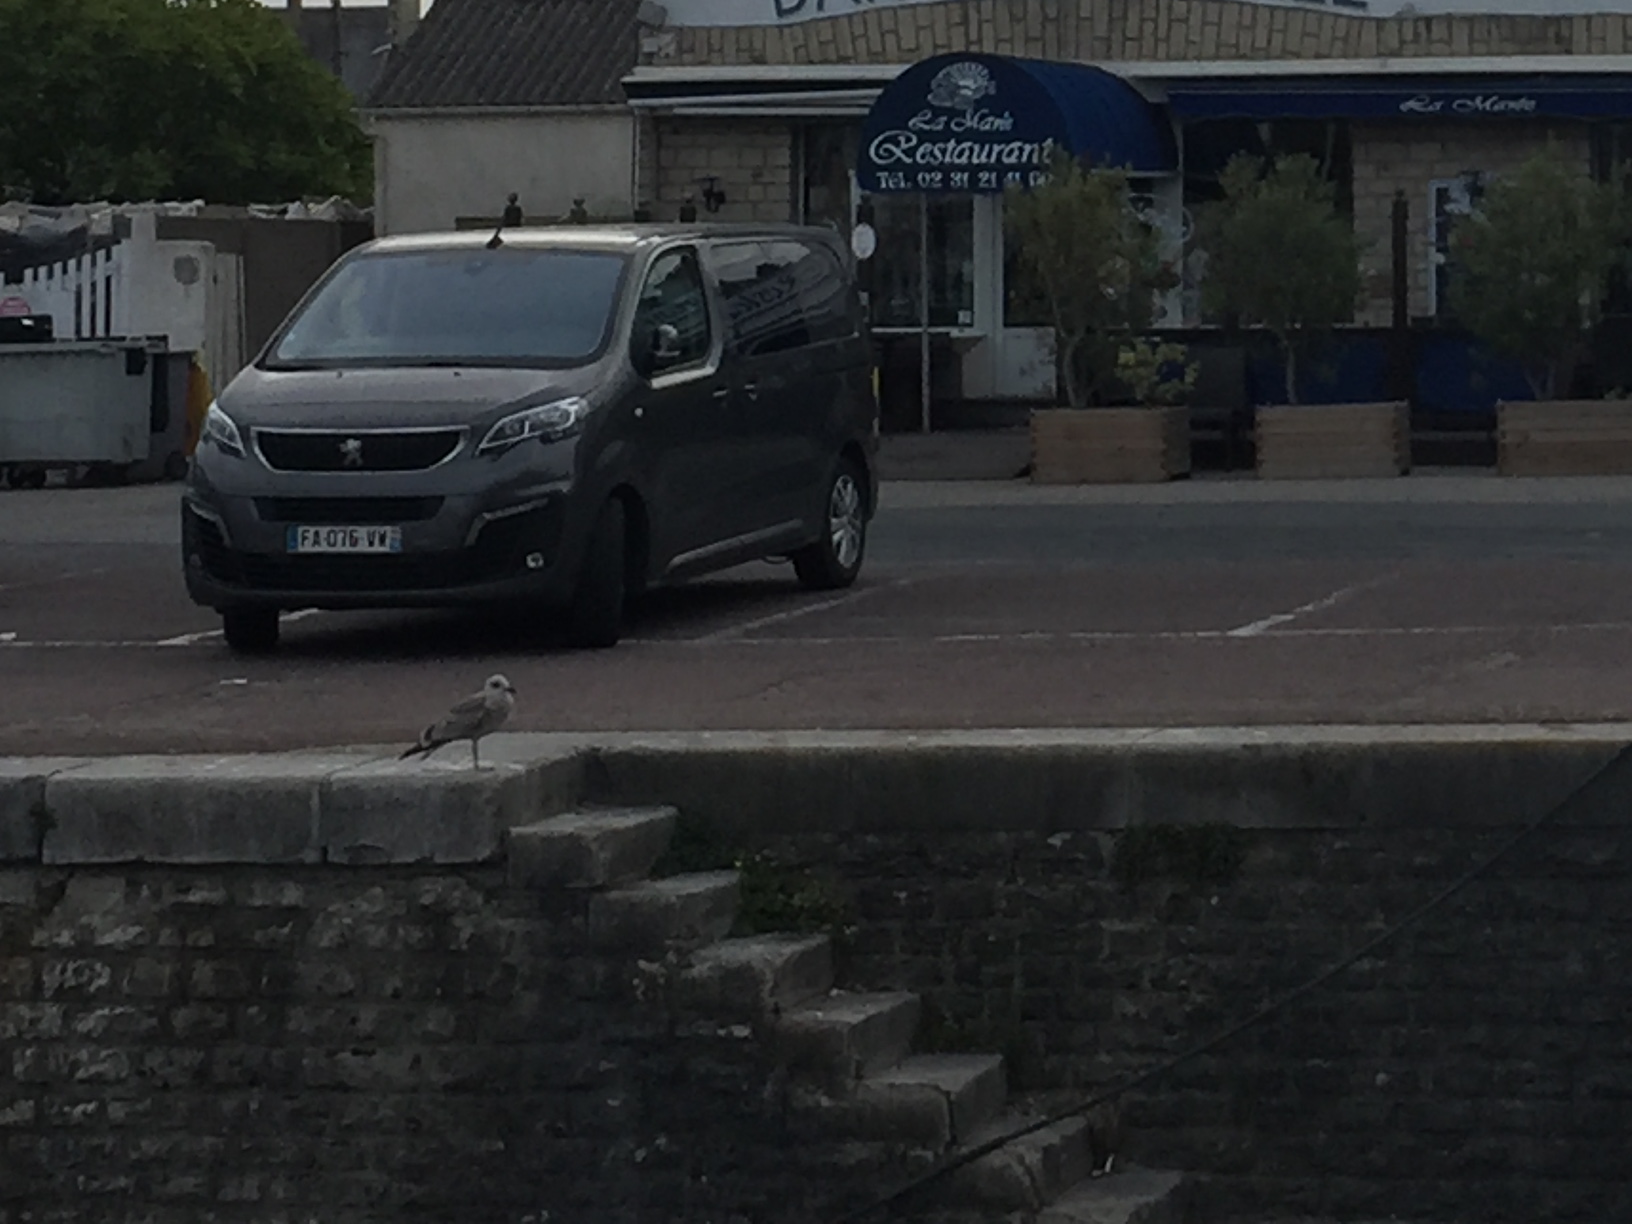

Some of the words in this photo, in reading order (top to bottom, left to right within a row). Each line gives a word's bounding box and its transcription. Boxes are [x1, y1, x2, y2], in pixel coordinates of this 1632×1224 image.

[1398, 93, 1445, 113] La
[907, 109, 947, 132] La
[868, 129, 1055, 167] Restaurant
[916, 170, 944, 188] 02
[949, 170, 970, 189] 31
[976, 170, 998, 188] 21
